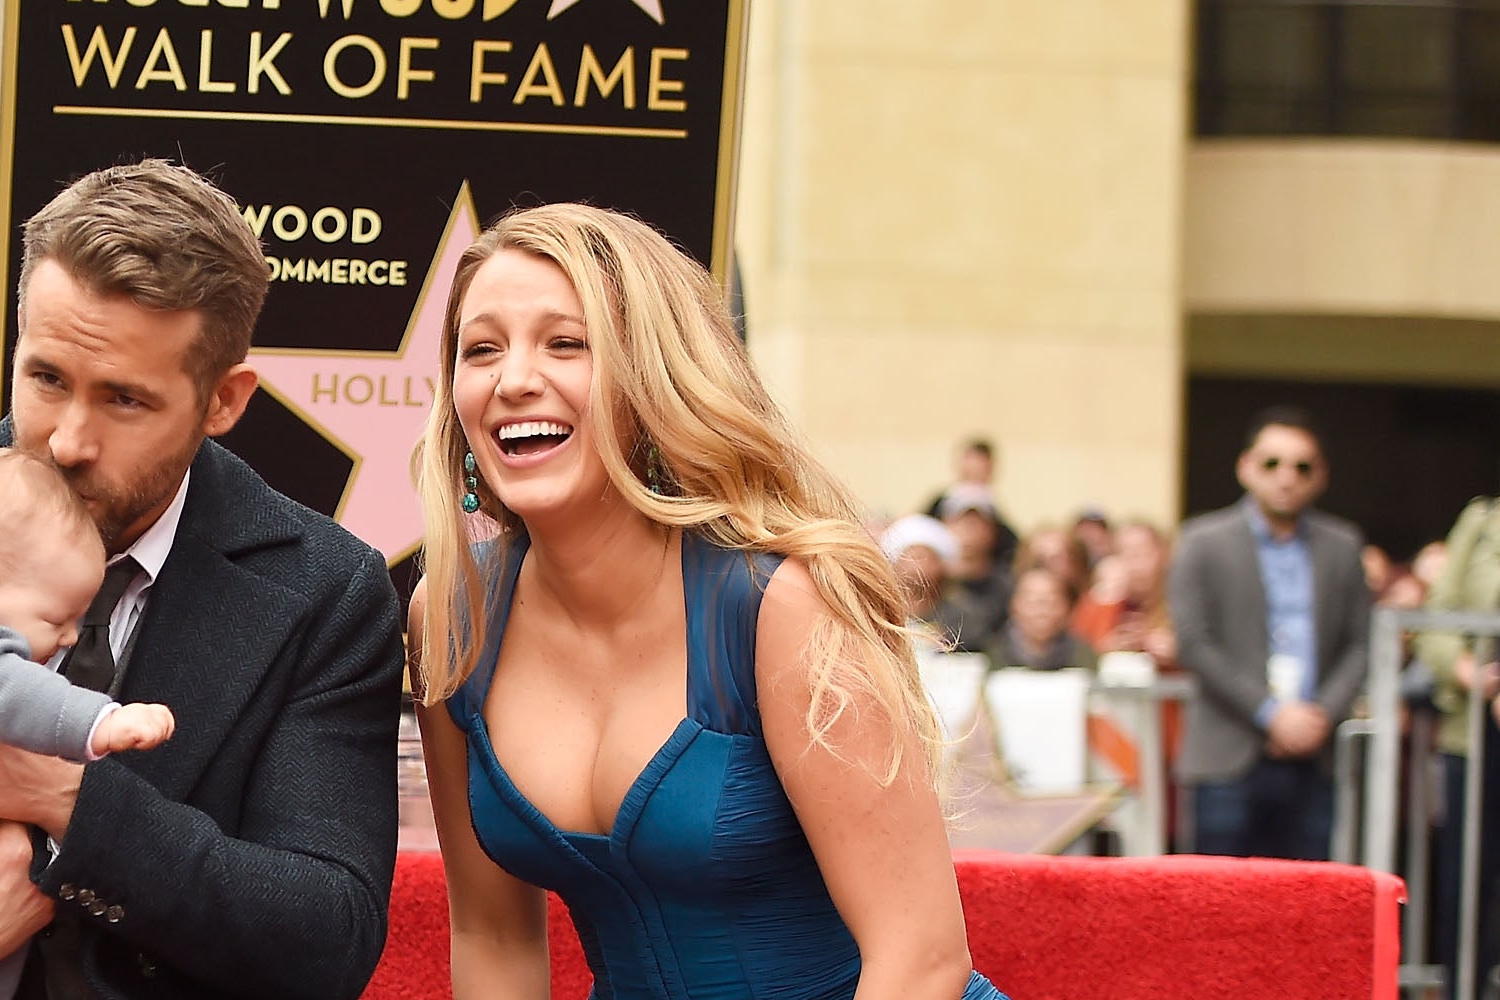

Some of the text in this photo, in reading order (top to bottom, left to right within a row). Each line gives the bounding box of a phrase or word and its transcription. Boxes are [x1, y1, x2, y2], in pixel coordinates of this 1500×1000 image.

[61, 24, 690, 111] WALK OF FAME
[243, 204, 382, 244] WOOD
[264, 256, 408, 286] OMMERCE
